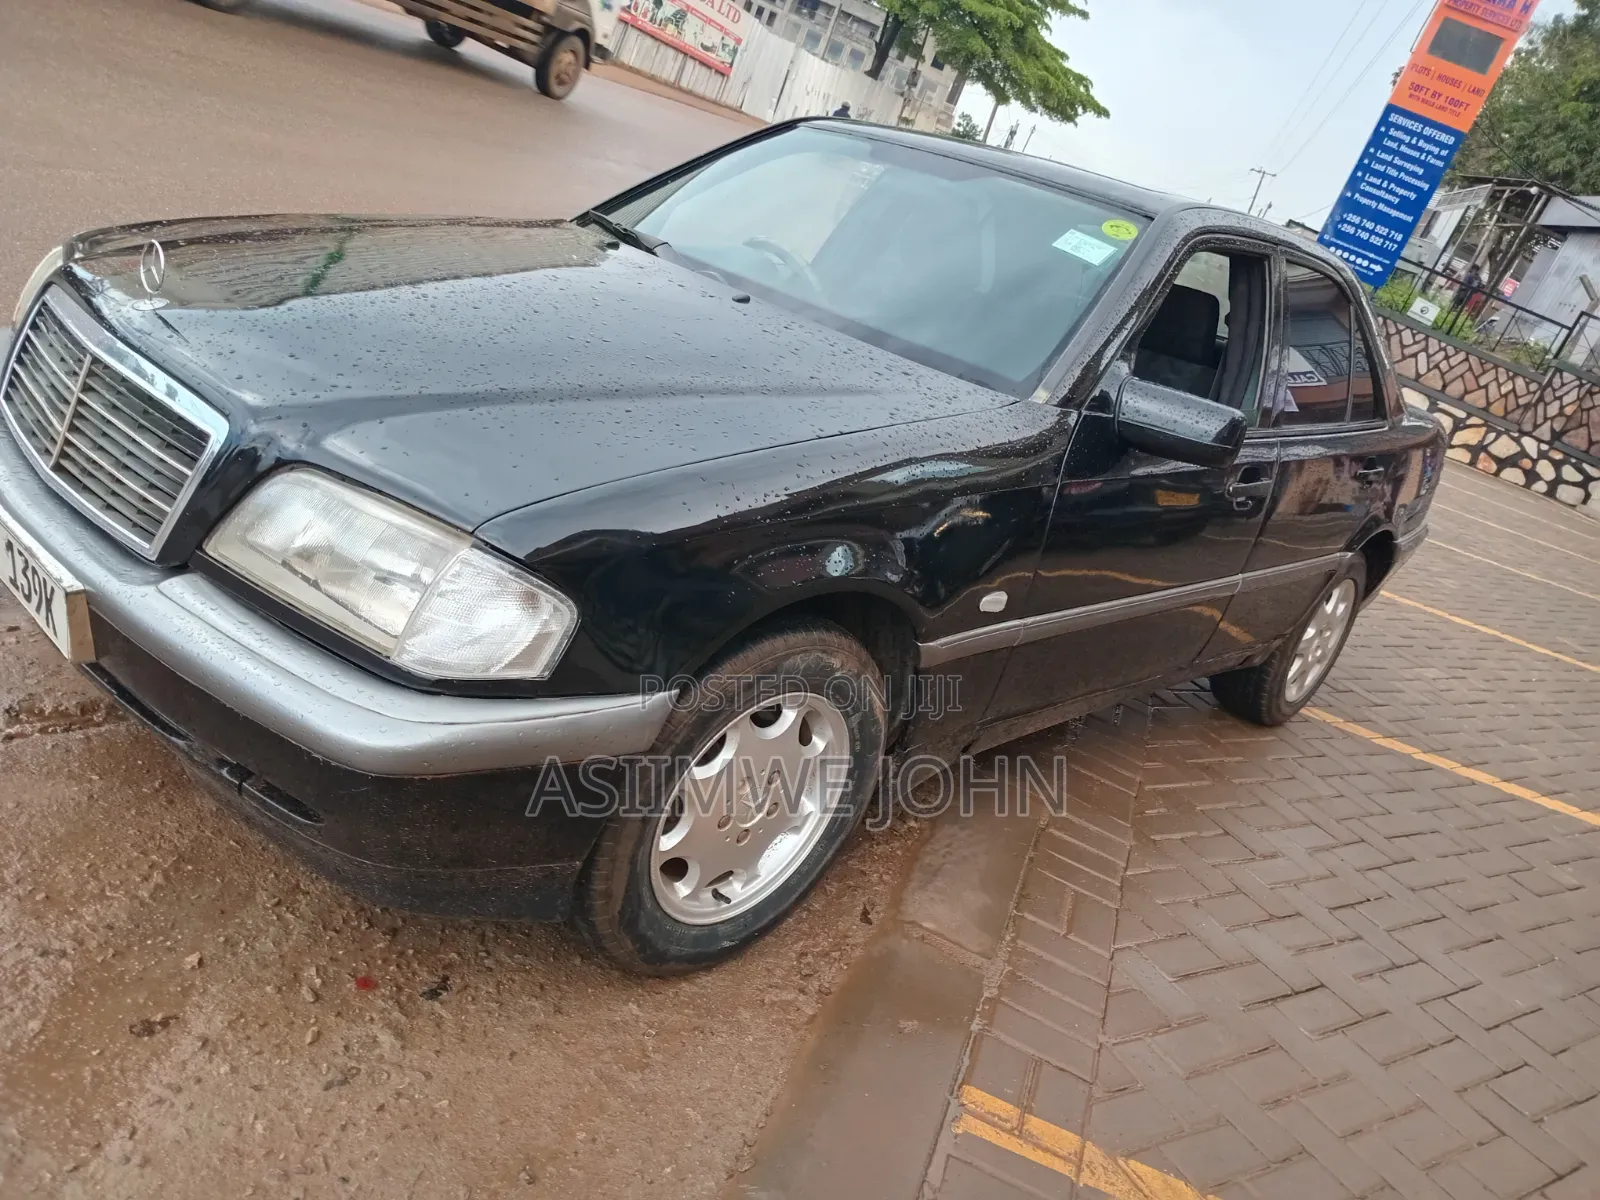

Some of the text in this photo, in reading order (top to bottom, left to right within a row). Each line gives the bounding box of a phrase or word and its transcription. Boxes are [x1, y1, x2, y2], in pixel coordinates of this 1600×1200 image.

[717, 0, 741, 24] LTD
[1482, 7, 1511, 25] SERVICES
[1510, 19, 1522, 29] LTD
[1411, 63, 1486, 98] PLOTS HOUSES LAND
[1408, 81, 1470, 112] 50FT BY 100FT
[1408, 93, 1421, 102] WITH
[1448, 108, 1462, 118] TITLE
[1388, 113, 1455, 145] SERVICES OFFERED
[1388, 128, 1450, 157] Selling & Buying of
[1376, 150, 1424, 176] Land Surveying
[1382, 137, 1445, 168] Land, Houses & Farms
[1364, 173, 1418, 200] Land & Property
[1370, 160, 1430, 191] Land Title Processing
[1354, 192, 1414, 222] Property Management
[1360, 182, 1400, 204] Consultancy
[1338, 224, 1356, 234] +256
[1356, 229, 1370, 240] 740
[1369, 234, 1384, 246] 522
[1383, 240, 1398, 252] 717
[1343, 212, 1404, 242] +256 740 522 718
[5, 538, 58, 639] 139K
